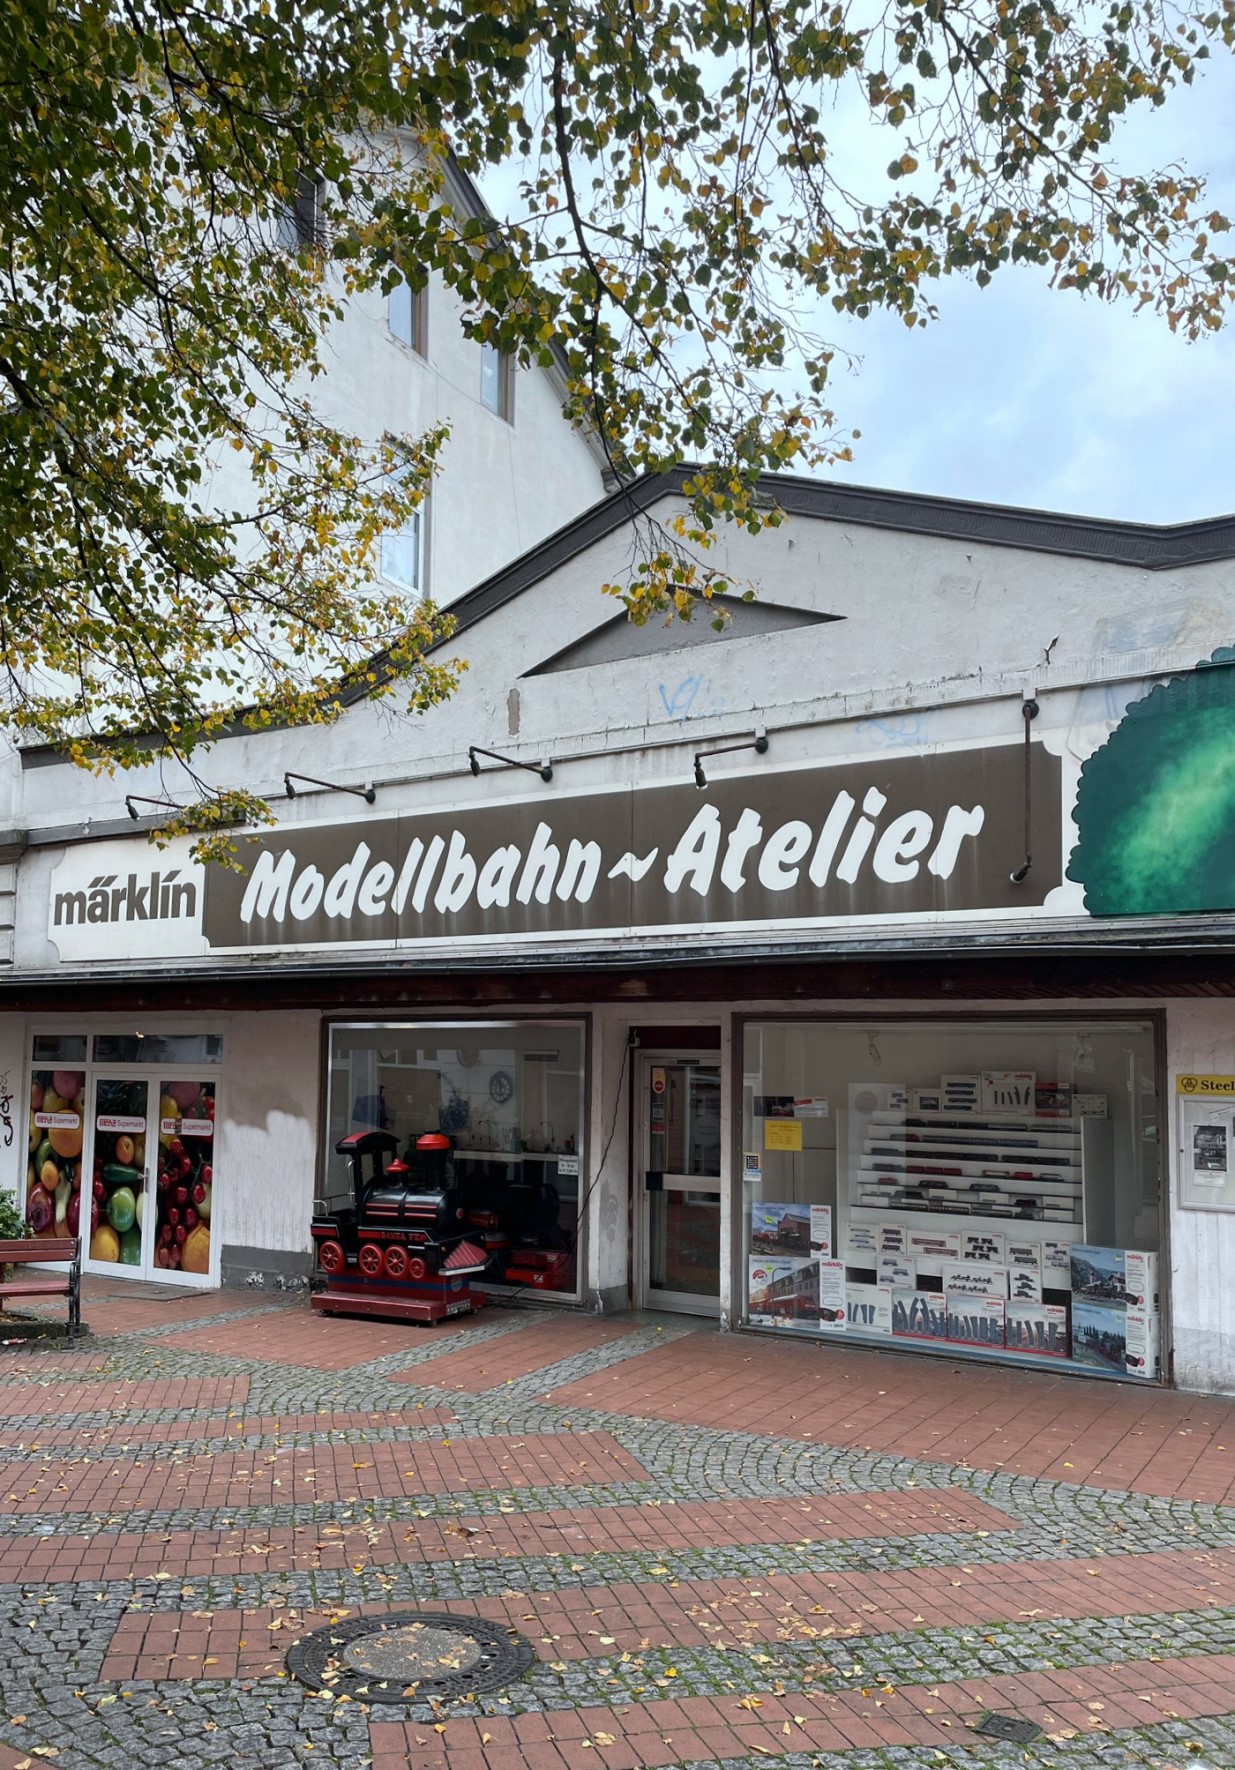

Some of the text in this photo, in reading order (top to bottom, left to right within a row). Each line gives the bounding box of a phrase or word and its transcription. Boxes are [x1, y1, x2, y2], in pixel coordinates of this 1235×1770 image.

[240, 822, 602, 924] Modellbahn
[663, 785, 986, 898] Atelier
[1200, 1079, 1235, 1091] Steel
[117, 1120, 144, 1129] Supermarkt
[182, 1122, 211, 1131] Supermarkt
